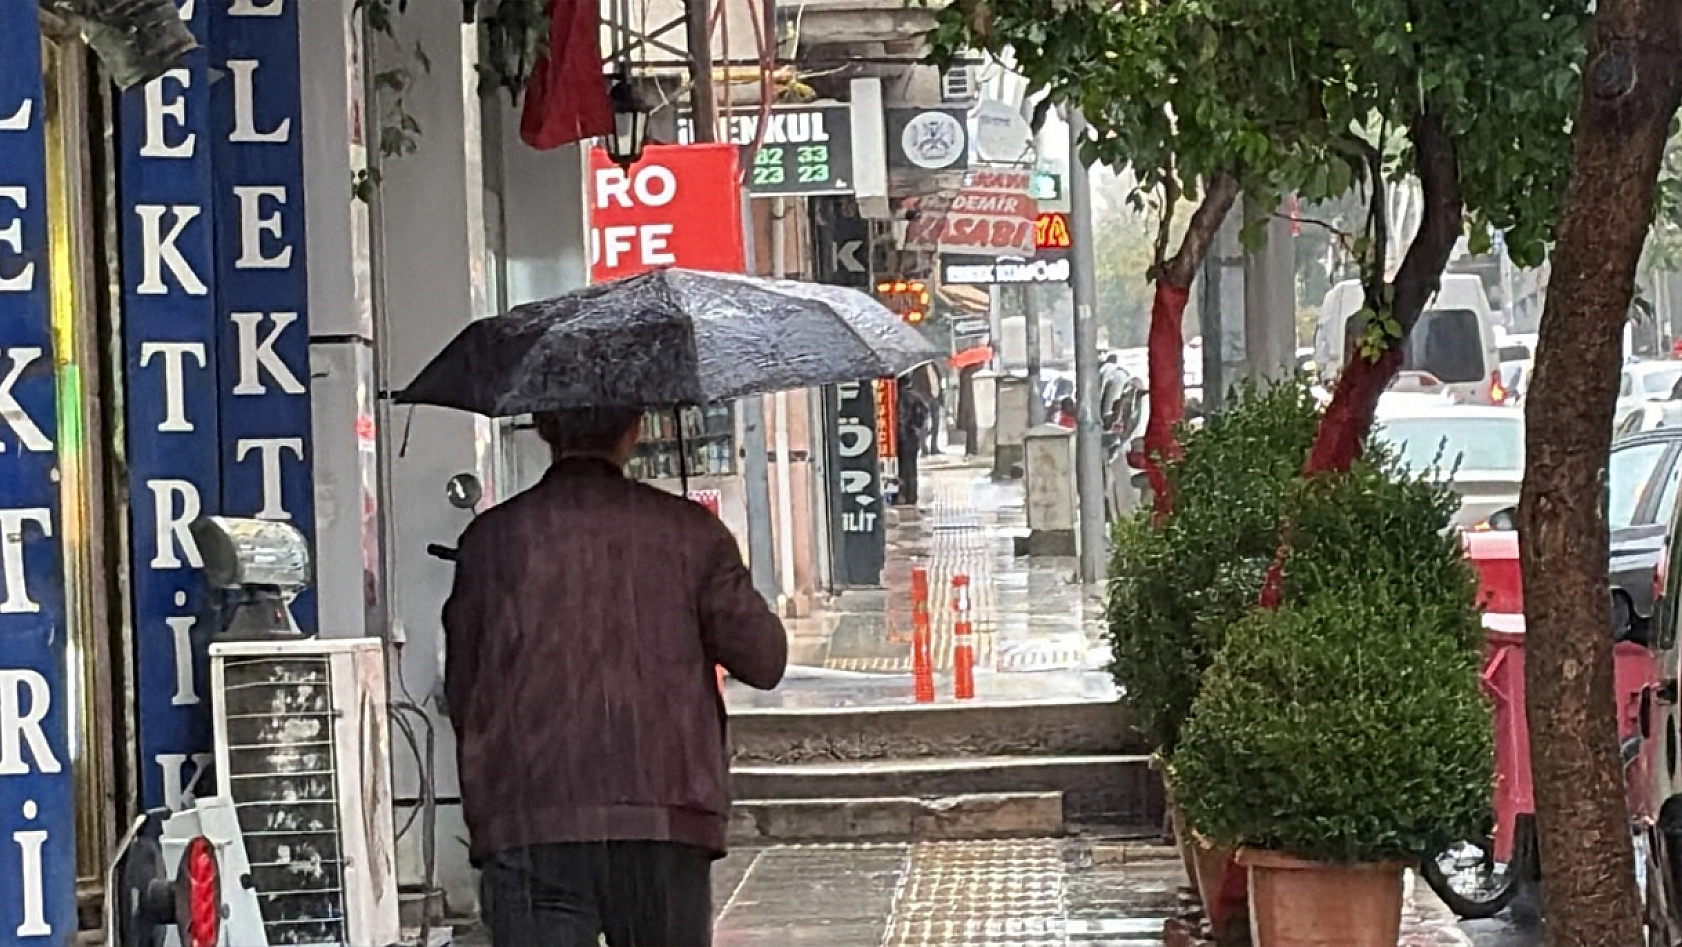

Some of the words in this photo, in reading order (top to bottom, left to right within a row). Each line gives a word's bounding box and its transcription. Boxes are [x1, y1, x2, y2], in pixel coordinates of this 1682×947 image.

[797, 145, 828, 163] 33
[753, 166, 785, 184] 23
[798, 164, 830, 183] 23
